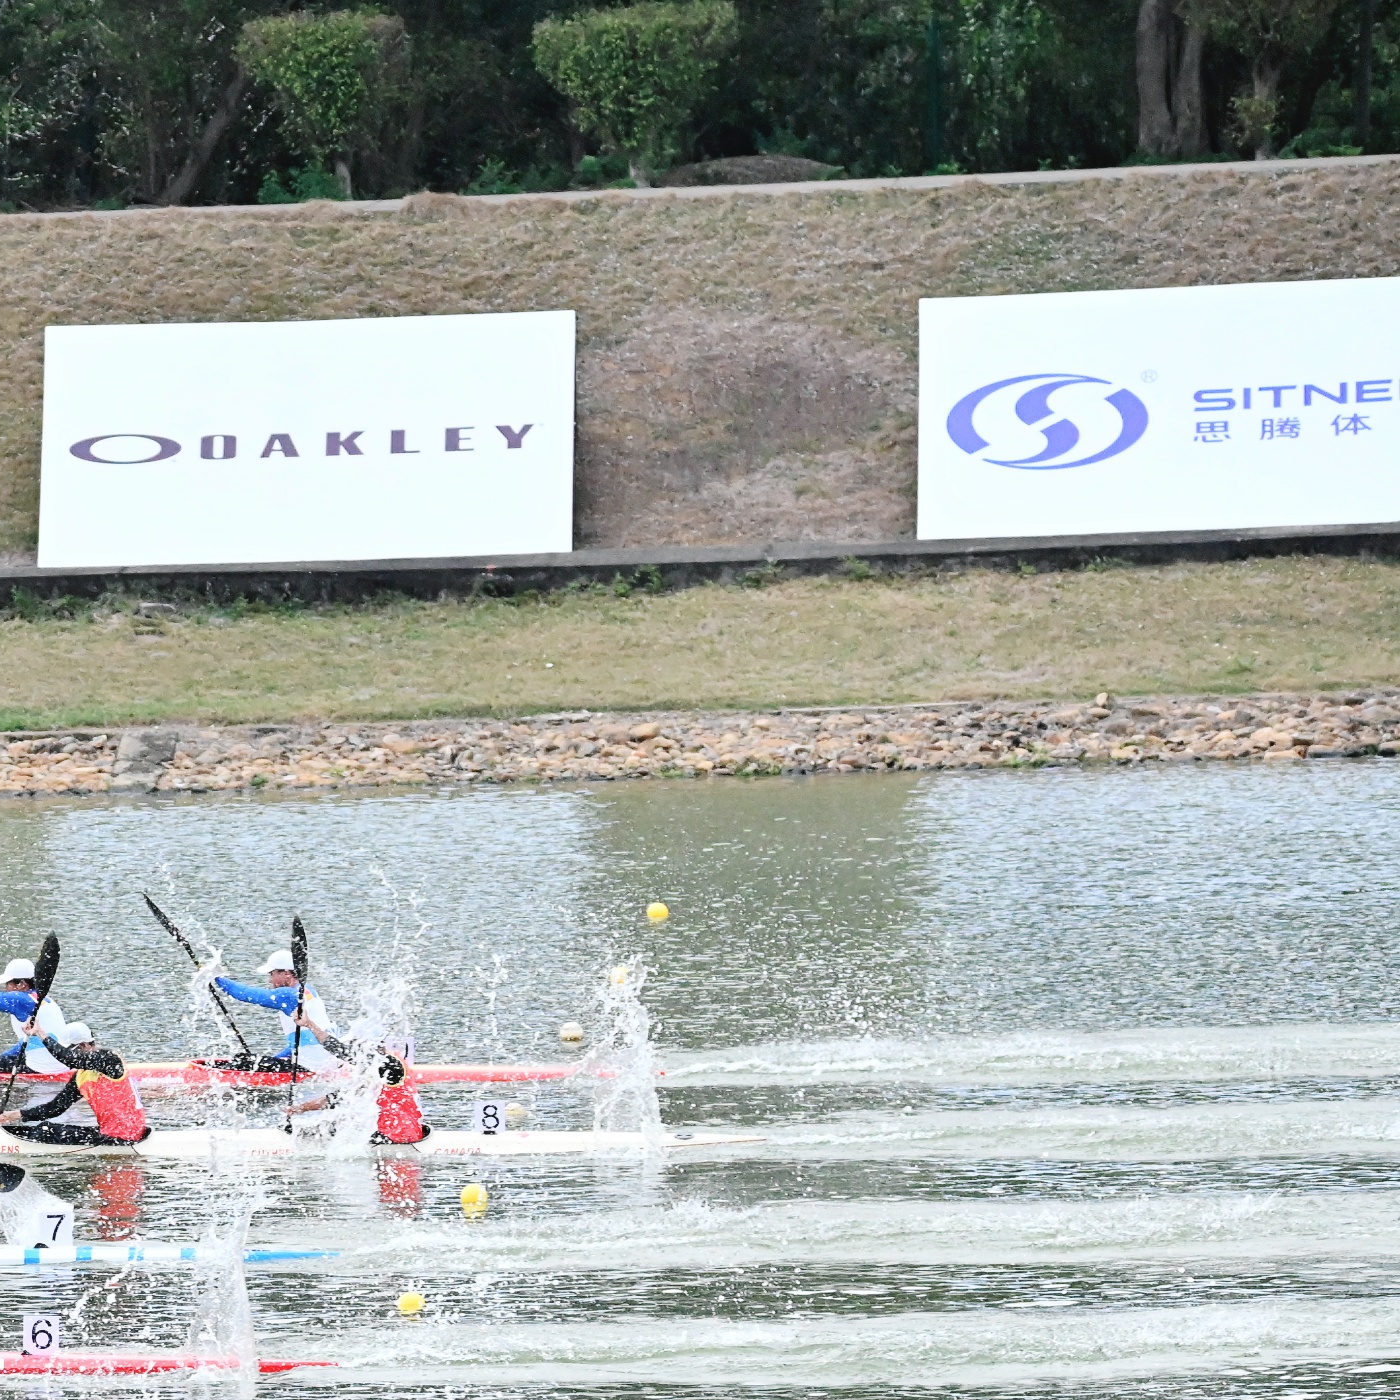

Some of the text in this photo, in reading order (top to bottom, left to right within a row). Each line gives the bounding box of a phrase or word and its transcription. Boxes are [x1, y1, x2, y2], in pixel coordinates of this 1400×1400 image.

[1193, 379, 1400, 412] SITNE
[200, 424, 534, 460] OAKLEY
[482, 1104, 499, 1129] 8
[46, 1214, 66, 1242] 7
[31, 1319, 53, 1350] 6
